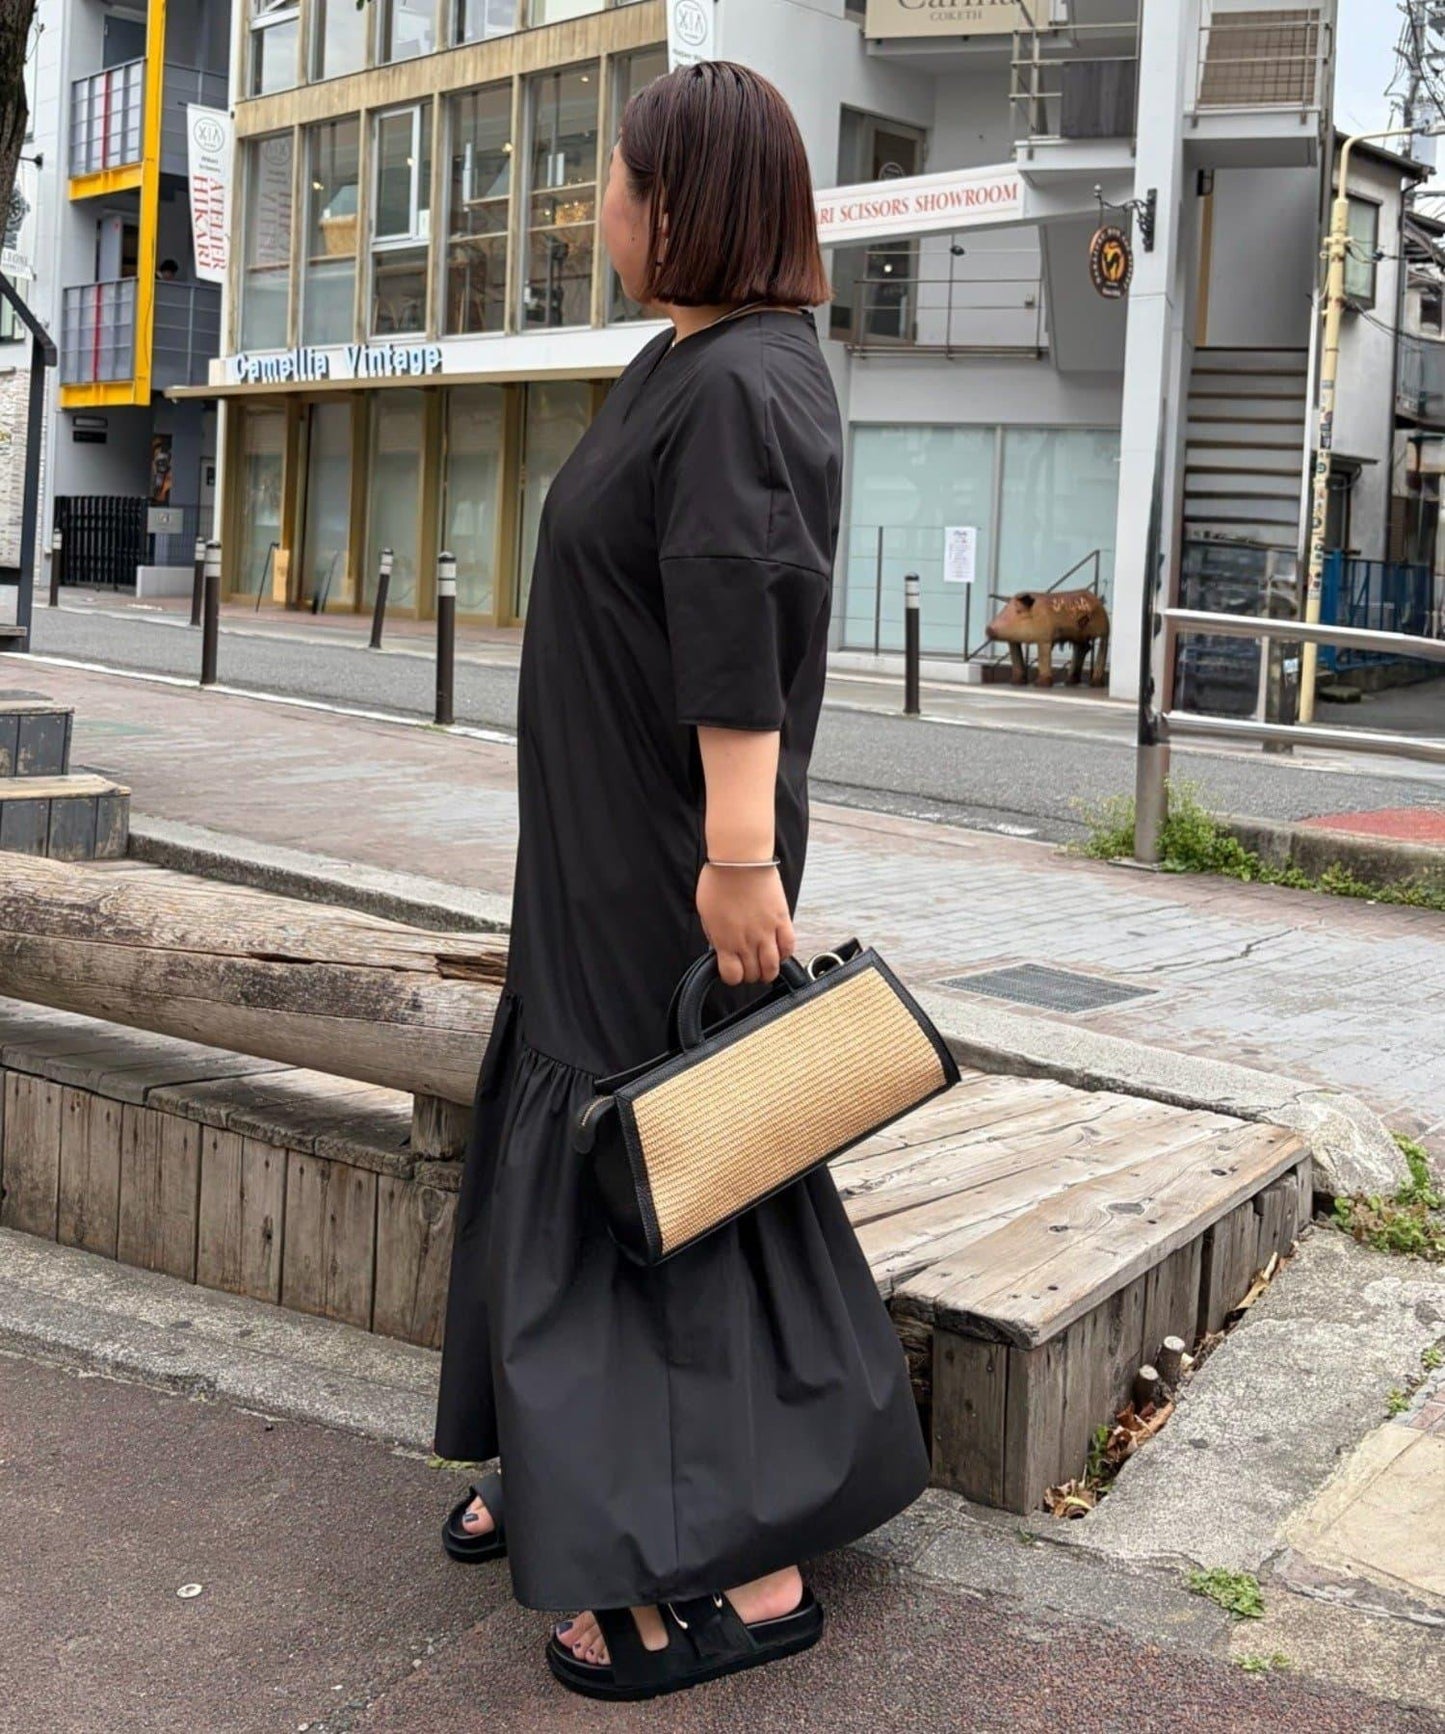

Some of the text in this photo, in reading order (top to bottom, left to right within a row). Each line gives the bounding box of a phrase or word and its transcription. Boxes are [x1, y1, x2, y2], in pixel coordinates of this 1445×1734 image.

[193, 174, 211, 269] HIKARI
[209, 177, 226, 270] ATELIER
[839, 196, 910, 223] SCISSORS
[914, 182, 1018, 213] SHOWROOM
[235, 343, 443, 385] Camellia Vintage
